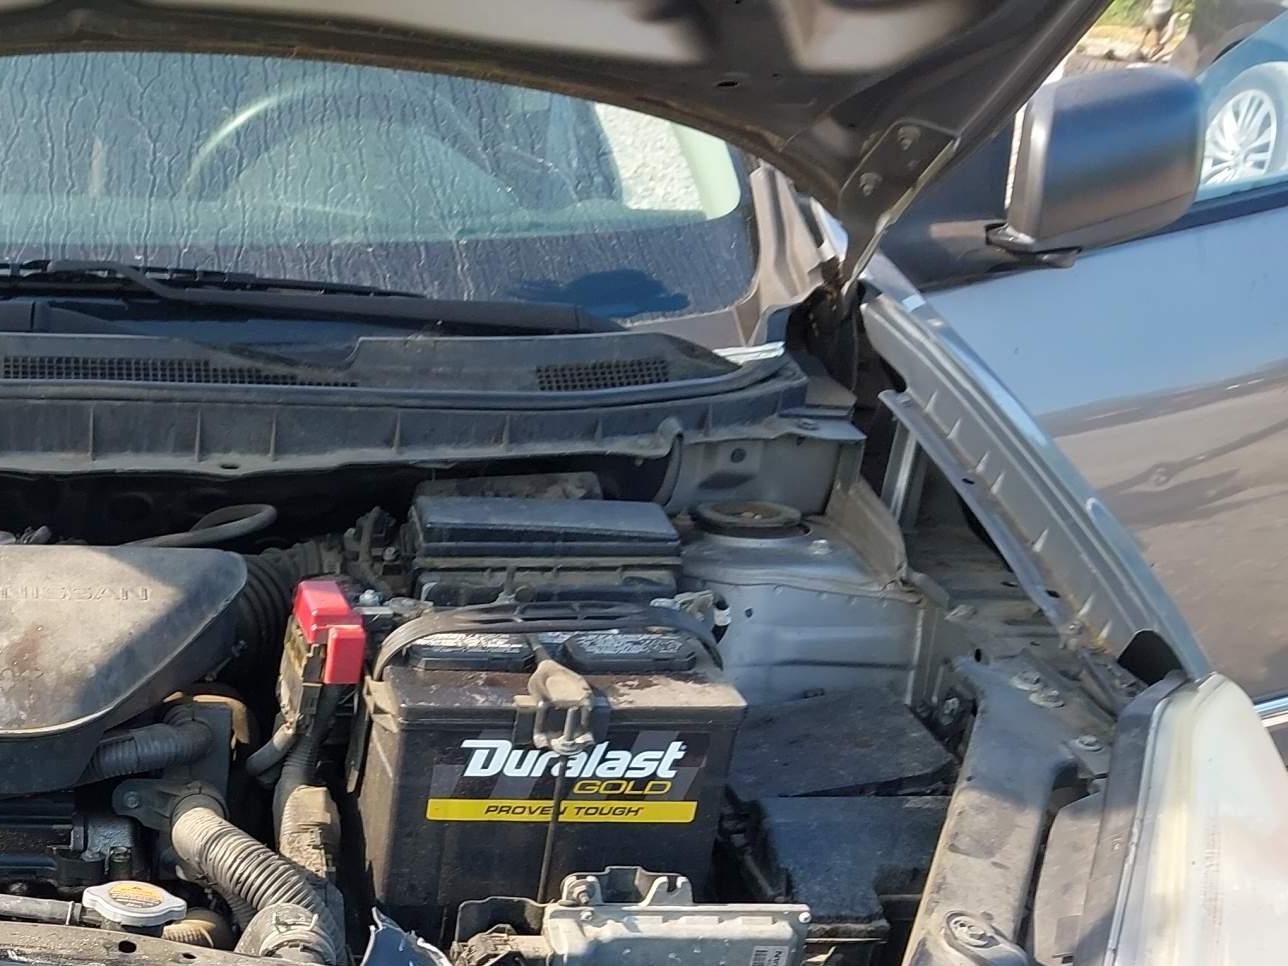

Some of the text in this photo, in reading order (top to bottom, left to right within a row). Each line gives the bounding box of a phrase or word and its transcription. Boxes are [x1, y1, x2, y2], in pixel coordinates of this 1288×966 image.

[460, 739, 687, 779] Duralast
[572, 780, 672, 795] GOLD
[573, 806, 642, 816] TOUGH
